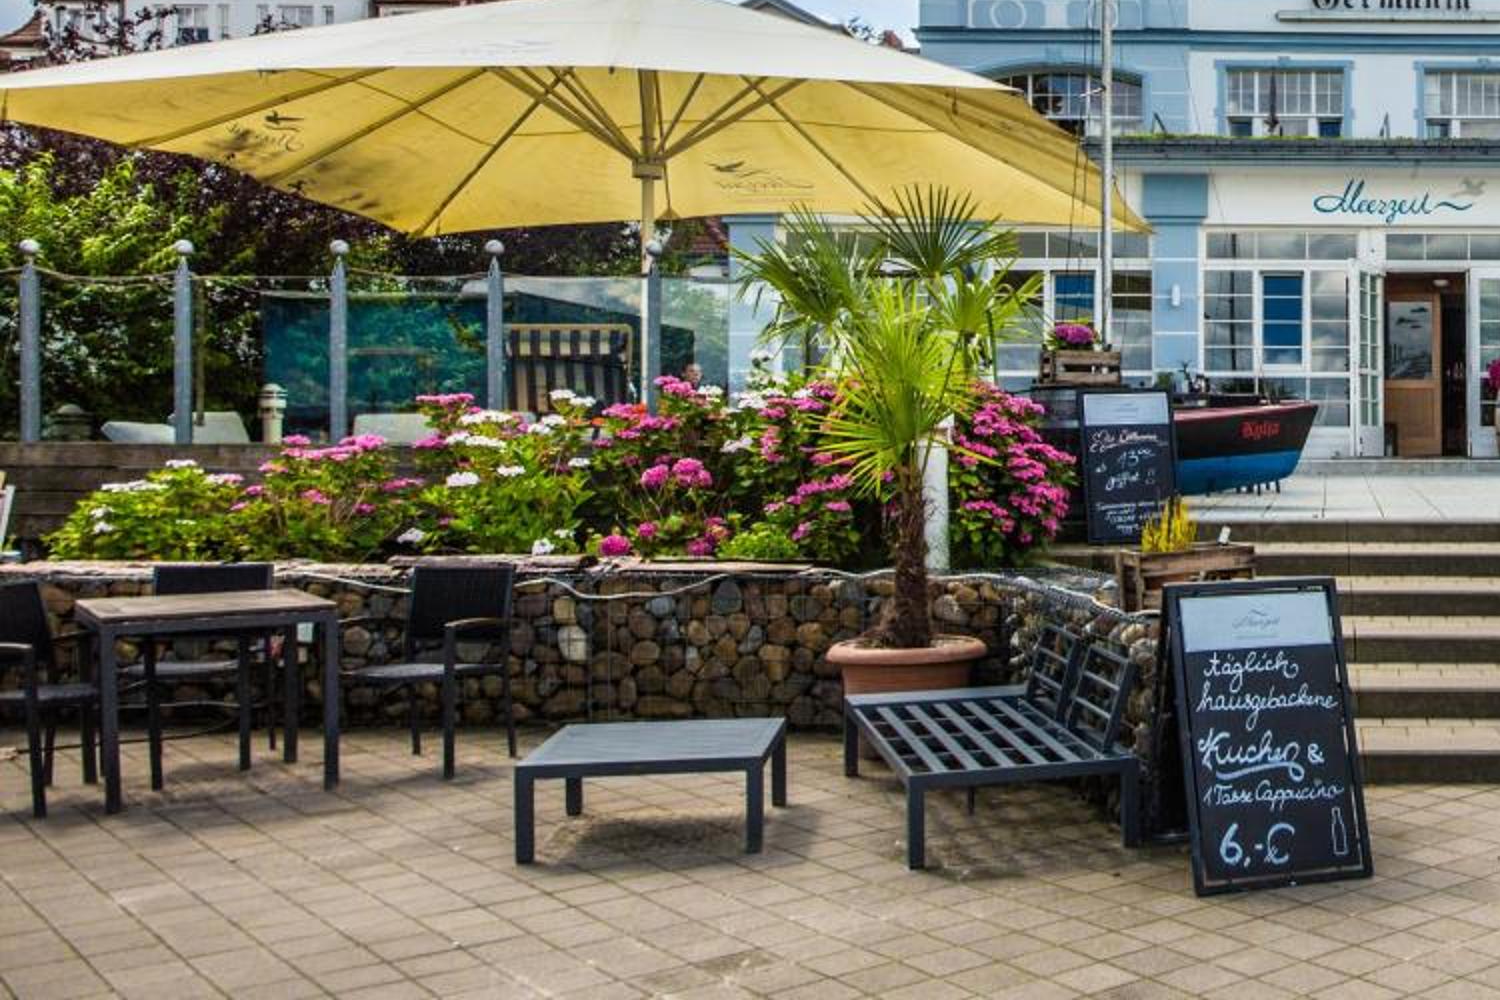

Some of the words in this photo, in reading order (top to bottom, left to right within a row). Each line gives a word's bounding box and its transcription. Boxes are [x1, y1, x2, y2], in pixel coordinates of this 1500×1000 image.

[1313, 178, 1432, 223] Meerzeit
[1203, 651, 1299, 693] täglich
[1307, 743, 1325, 764] &
